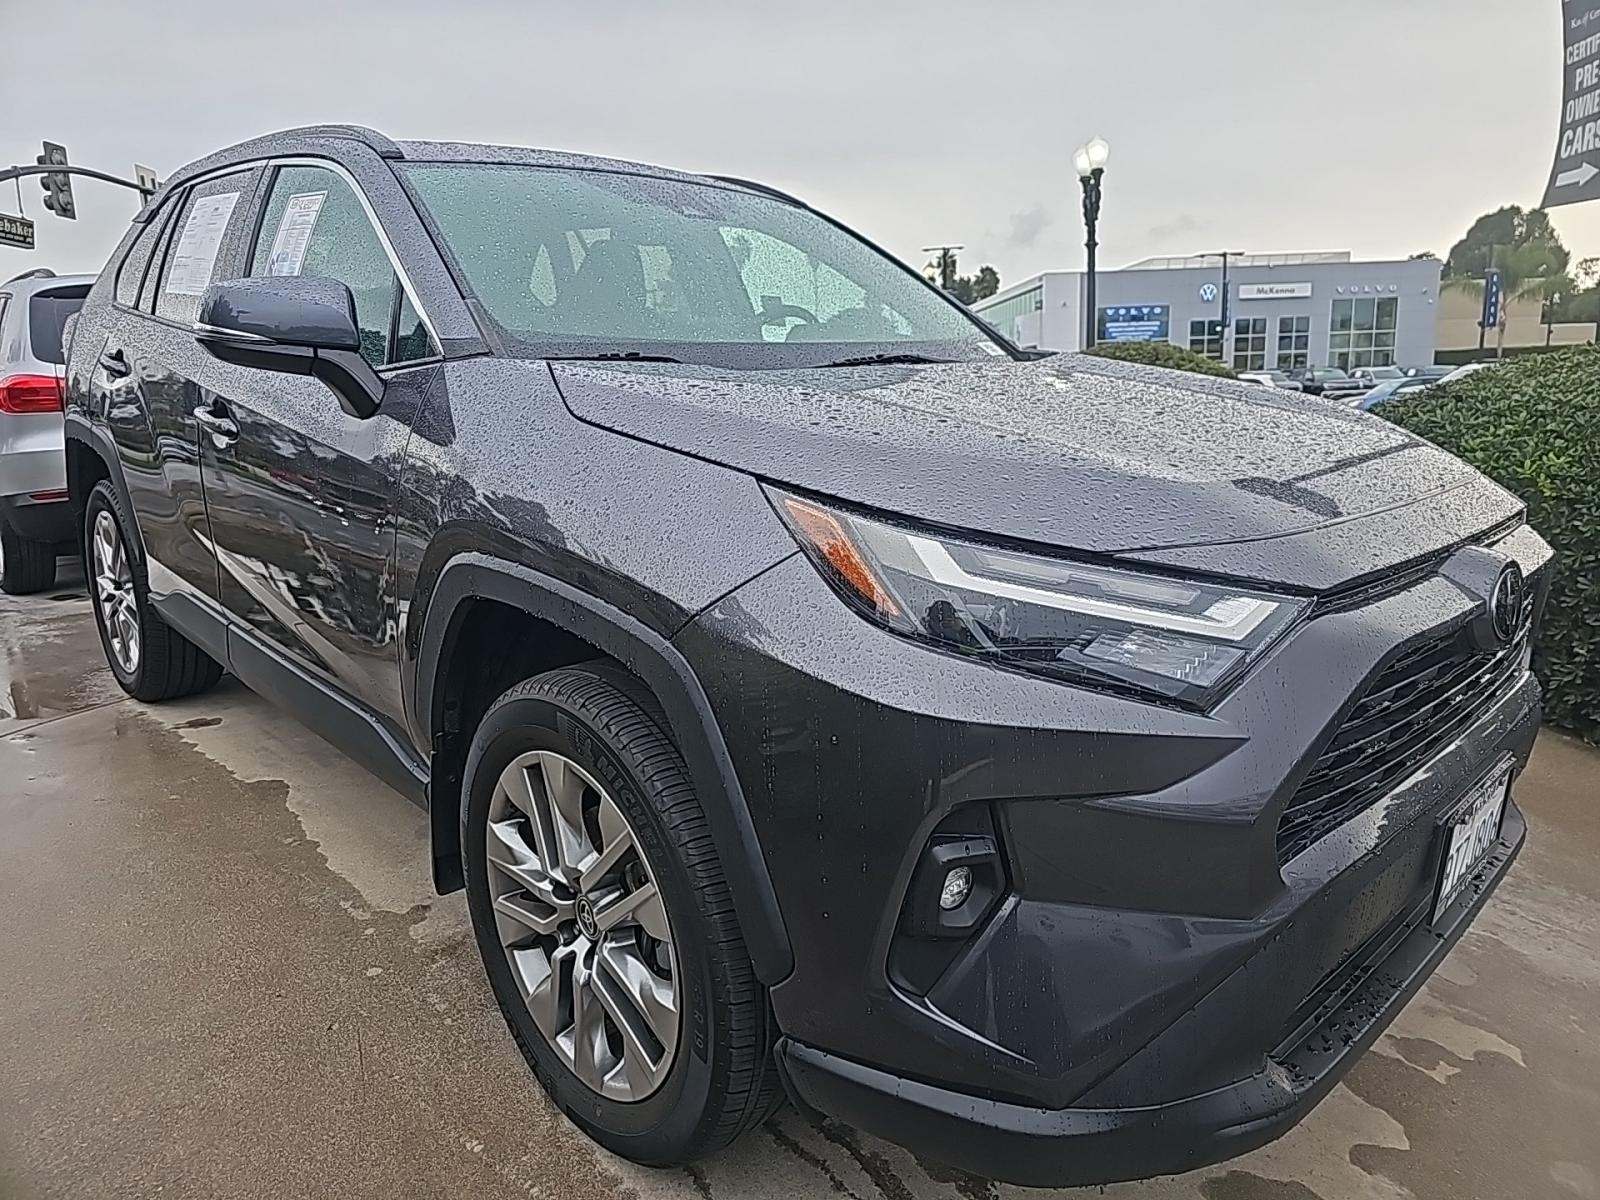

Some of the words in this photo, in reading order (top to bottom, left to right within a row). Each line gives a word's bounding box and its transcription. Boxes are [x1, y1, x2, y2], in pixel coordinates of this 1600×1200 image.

[1566, 89, 1600, 124] OWNE
[1256, 287, 1296, 295] McKenna
[1336, 284, 1398, 295] VOLVO
[1106, 306, 1162, 316] VOLVO
[596, 756, 664, 862] MICHEL
